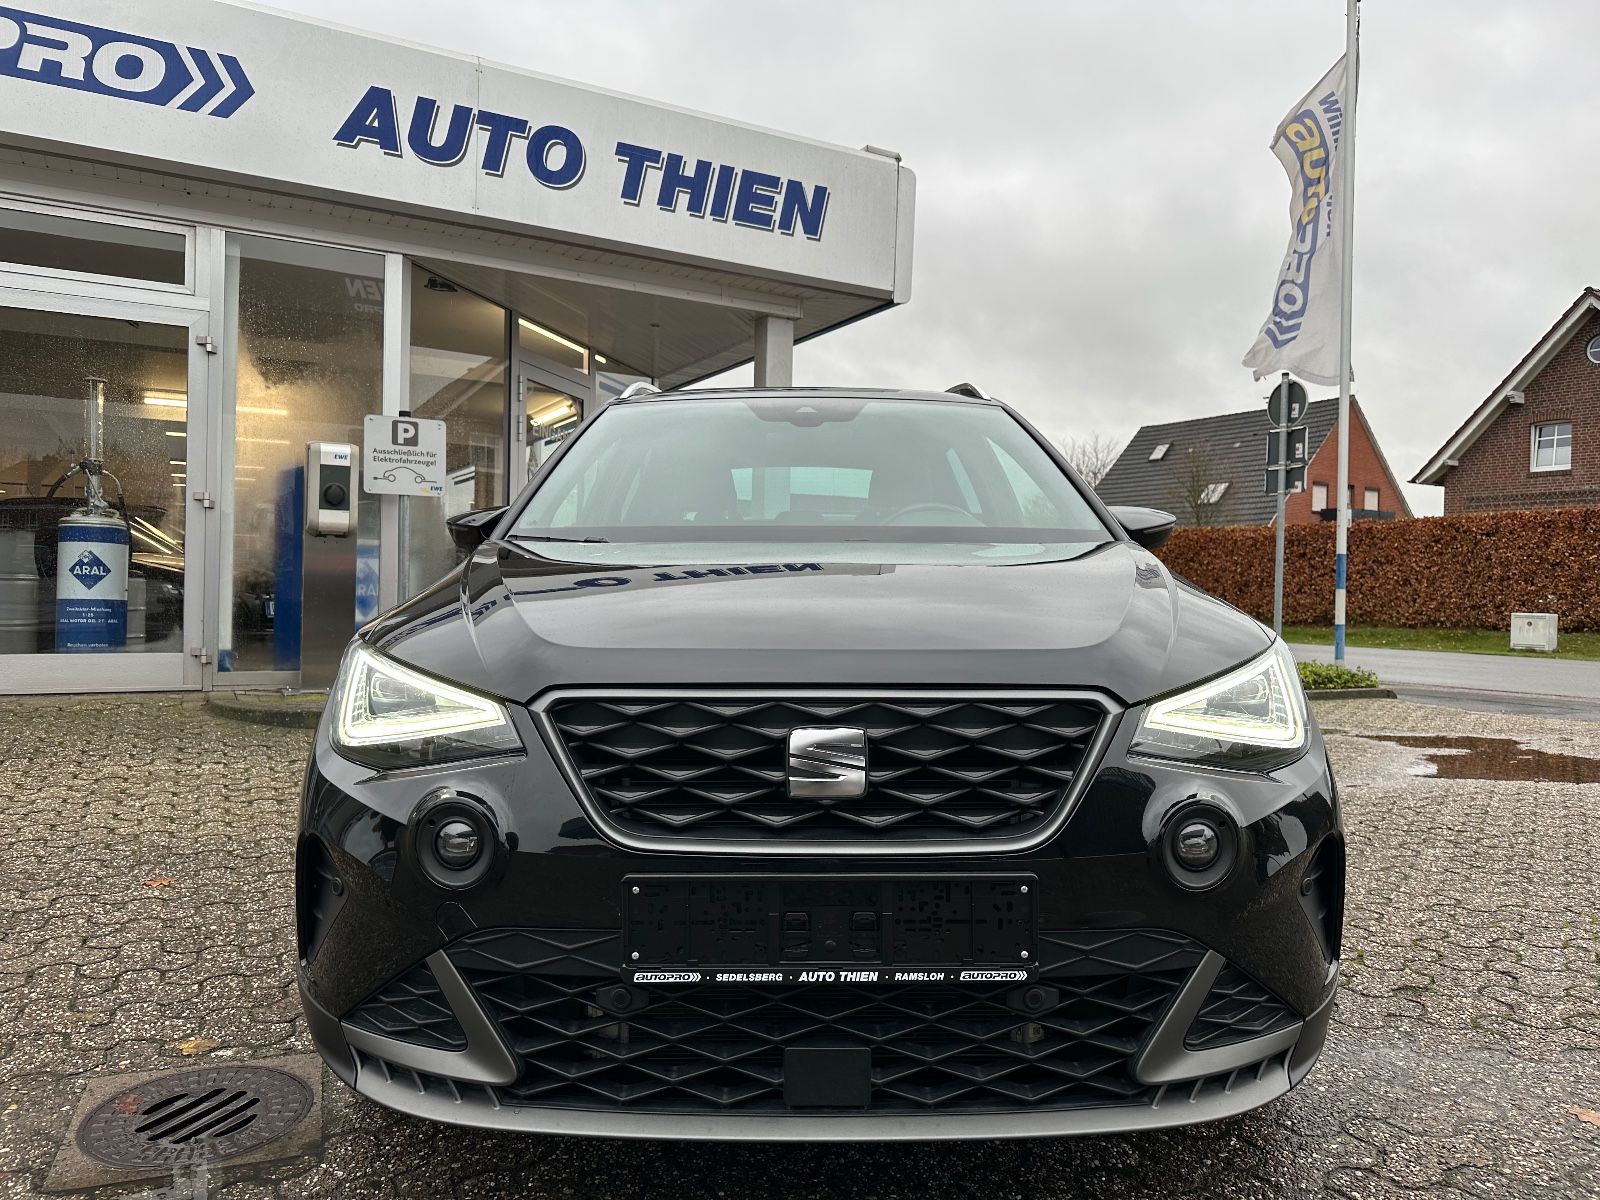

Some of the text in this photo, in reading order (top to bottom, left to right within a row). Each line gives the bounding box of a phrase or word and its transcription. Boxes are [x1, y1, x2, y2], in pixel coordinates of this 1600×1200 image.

[333, 85, 830, 241] AUTO THIEN
[397, 422, 416, 444] P
[372, 448, 438, 458] Ausschließlich für
[373, 456, 437, 466] Elektrofahrzeuge!
[73, 565, 107, 576] ARAL
[715, 973, 783, 982] SEDELSBERG
[798, 971, 836, 982] AUTO
[839, 971, 879, 982] THIEN
[894, 972, 945, 981] RAMSLOH
